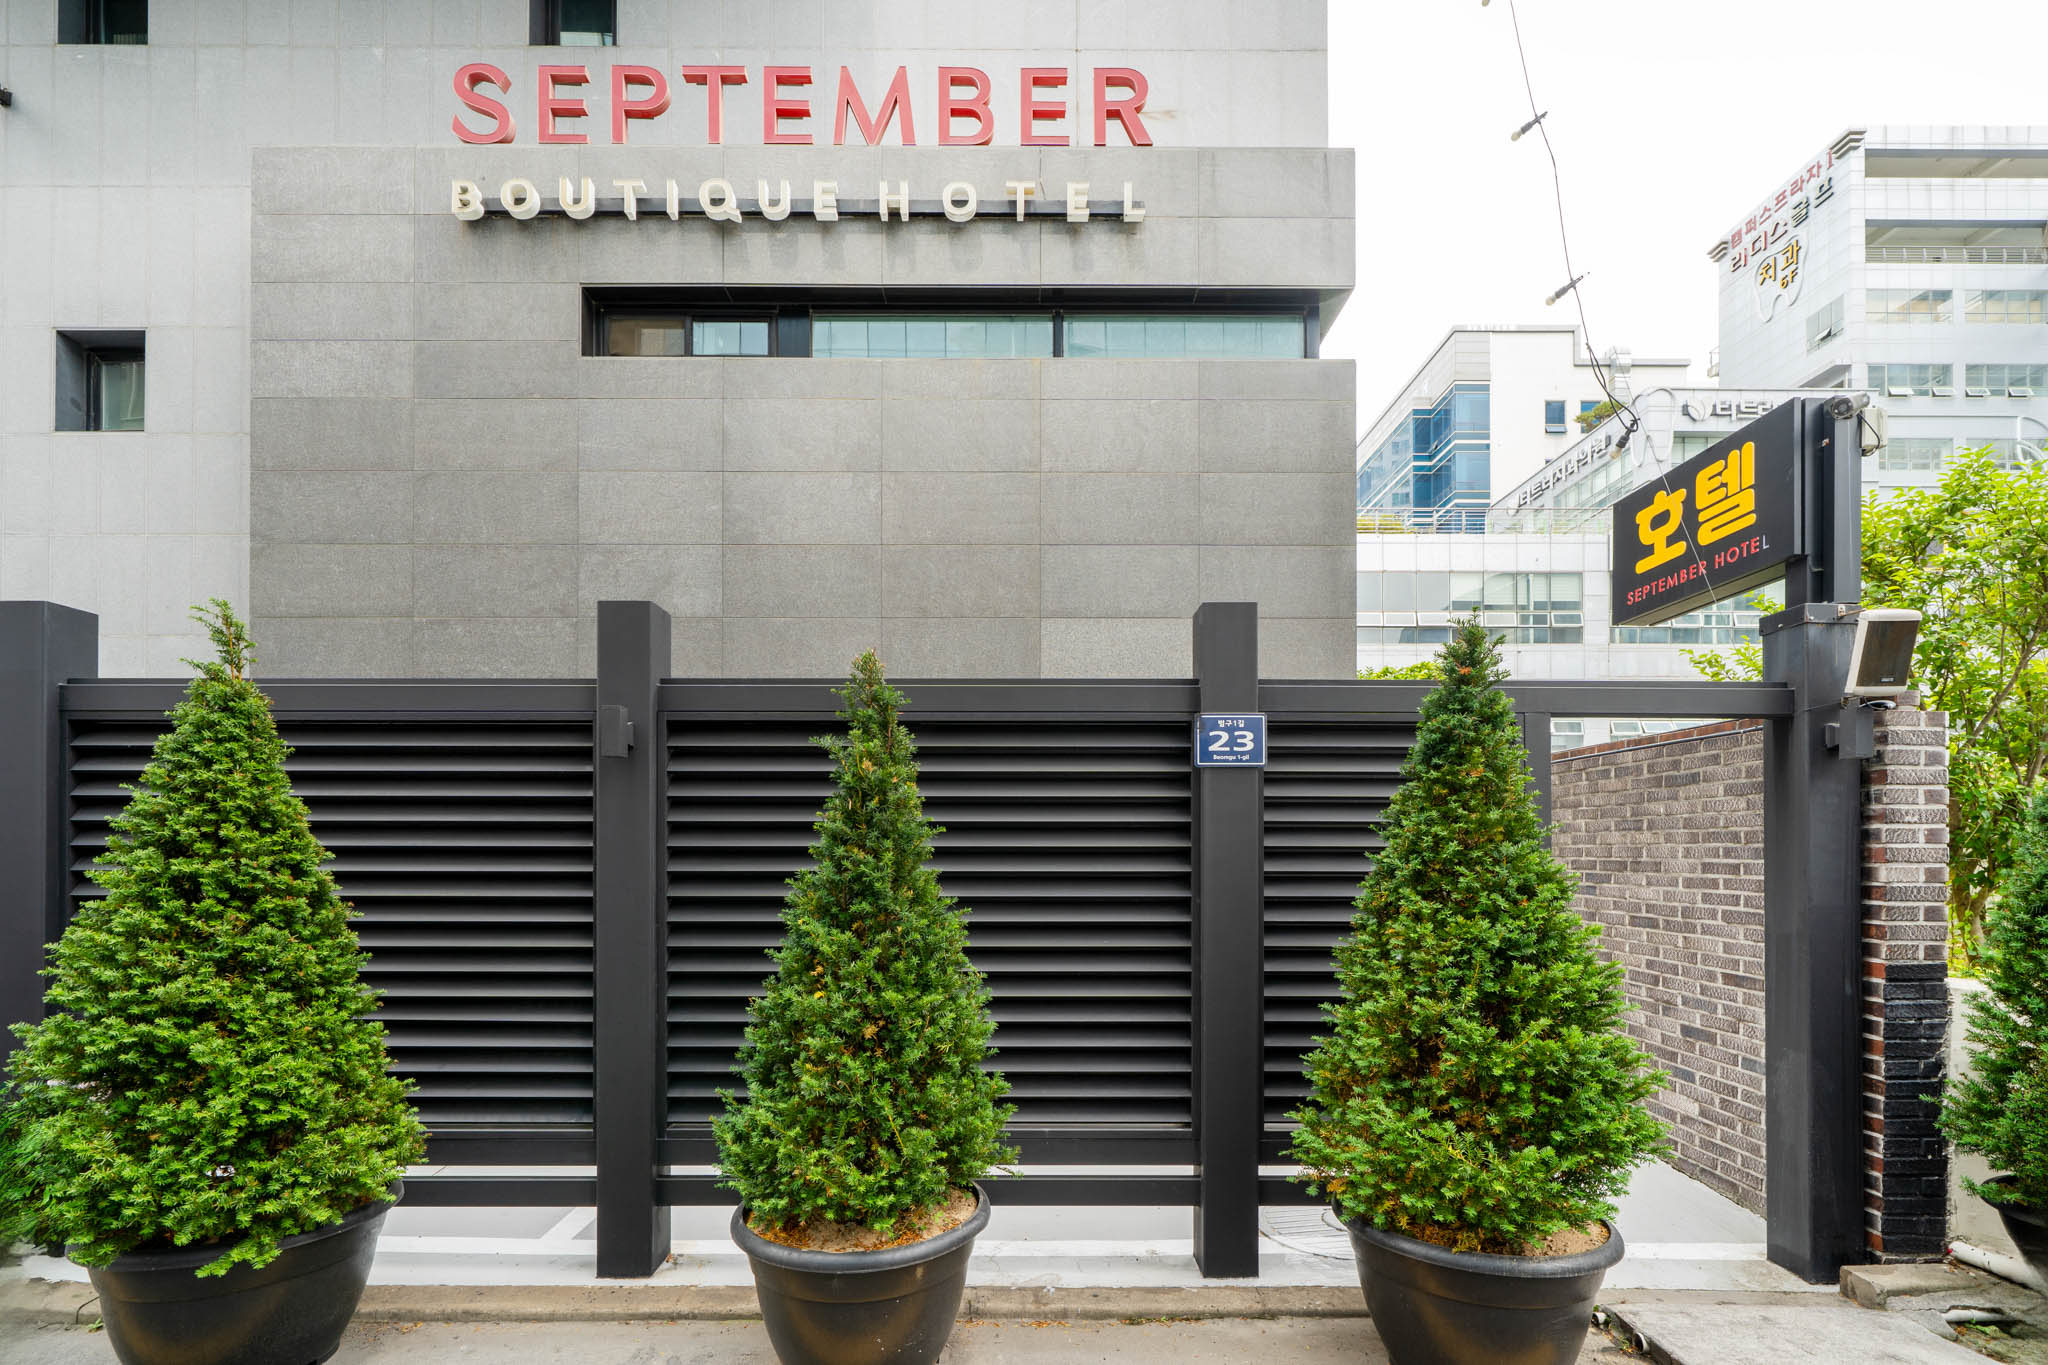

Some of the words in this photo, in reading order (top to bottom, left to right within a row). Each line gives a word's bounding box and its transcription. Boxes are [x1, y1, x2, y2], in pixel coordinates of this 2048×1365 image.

[451, 62, 1153, 147] SEPTEMBER
[451, 177, 842, 223] BOUTIQUE
[879, 180, 1147, 223] HOTEL
[1759, 239, 1802, 286] 치과
[1780, 266, 1799, 289] 6F
[1635, 441, 1757, 575] 호텔
[1626, 561, 1707, 606] SEPTEMBER
[1714, 534, 1770, 569] HOTEL
[1208, 730, 1255, 752] 23
